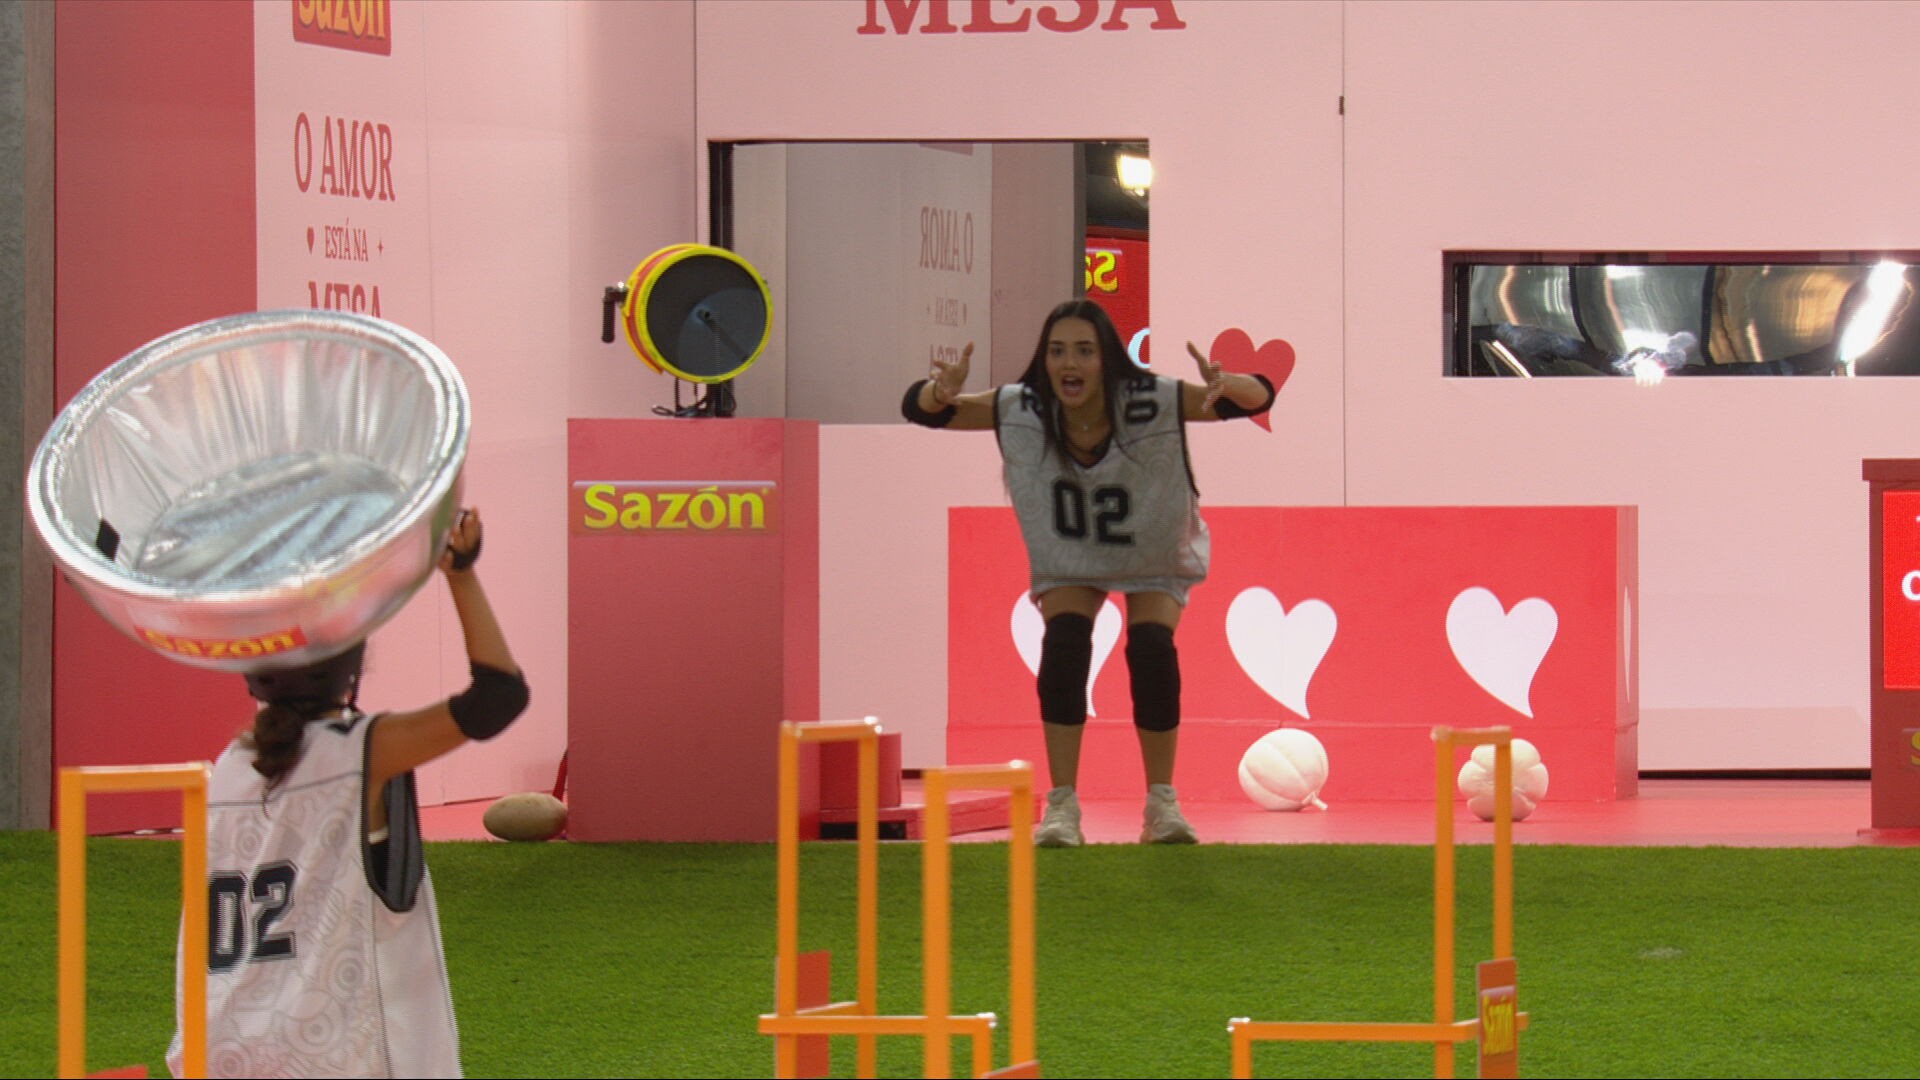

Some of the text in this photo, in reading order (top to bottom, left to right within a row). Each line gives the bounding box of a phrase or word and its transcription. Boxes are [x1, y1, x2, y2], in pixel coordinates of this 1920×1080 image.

[294, 112, 396, 202] O AMOR
[324, 216, 369, 262] ESTÁ NA
[584, 484, 766, 529] Sazón
[1053, 477, 1136, 546] 02
[207, 858, 299, 974] 02
